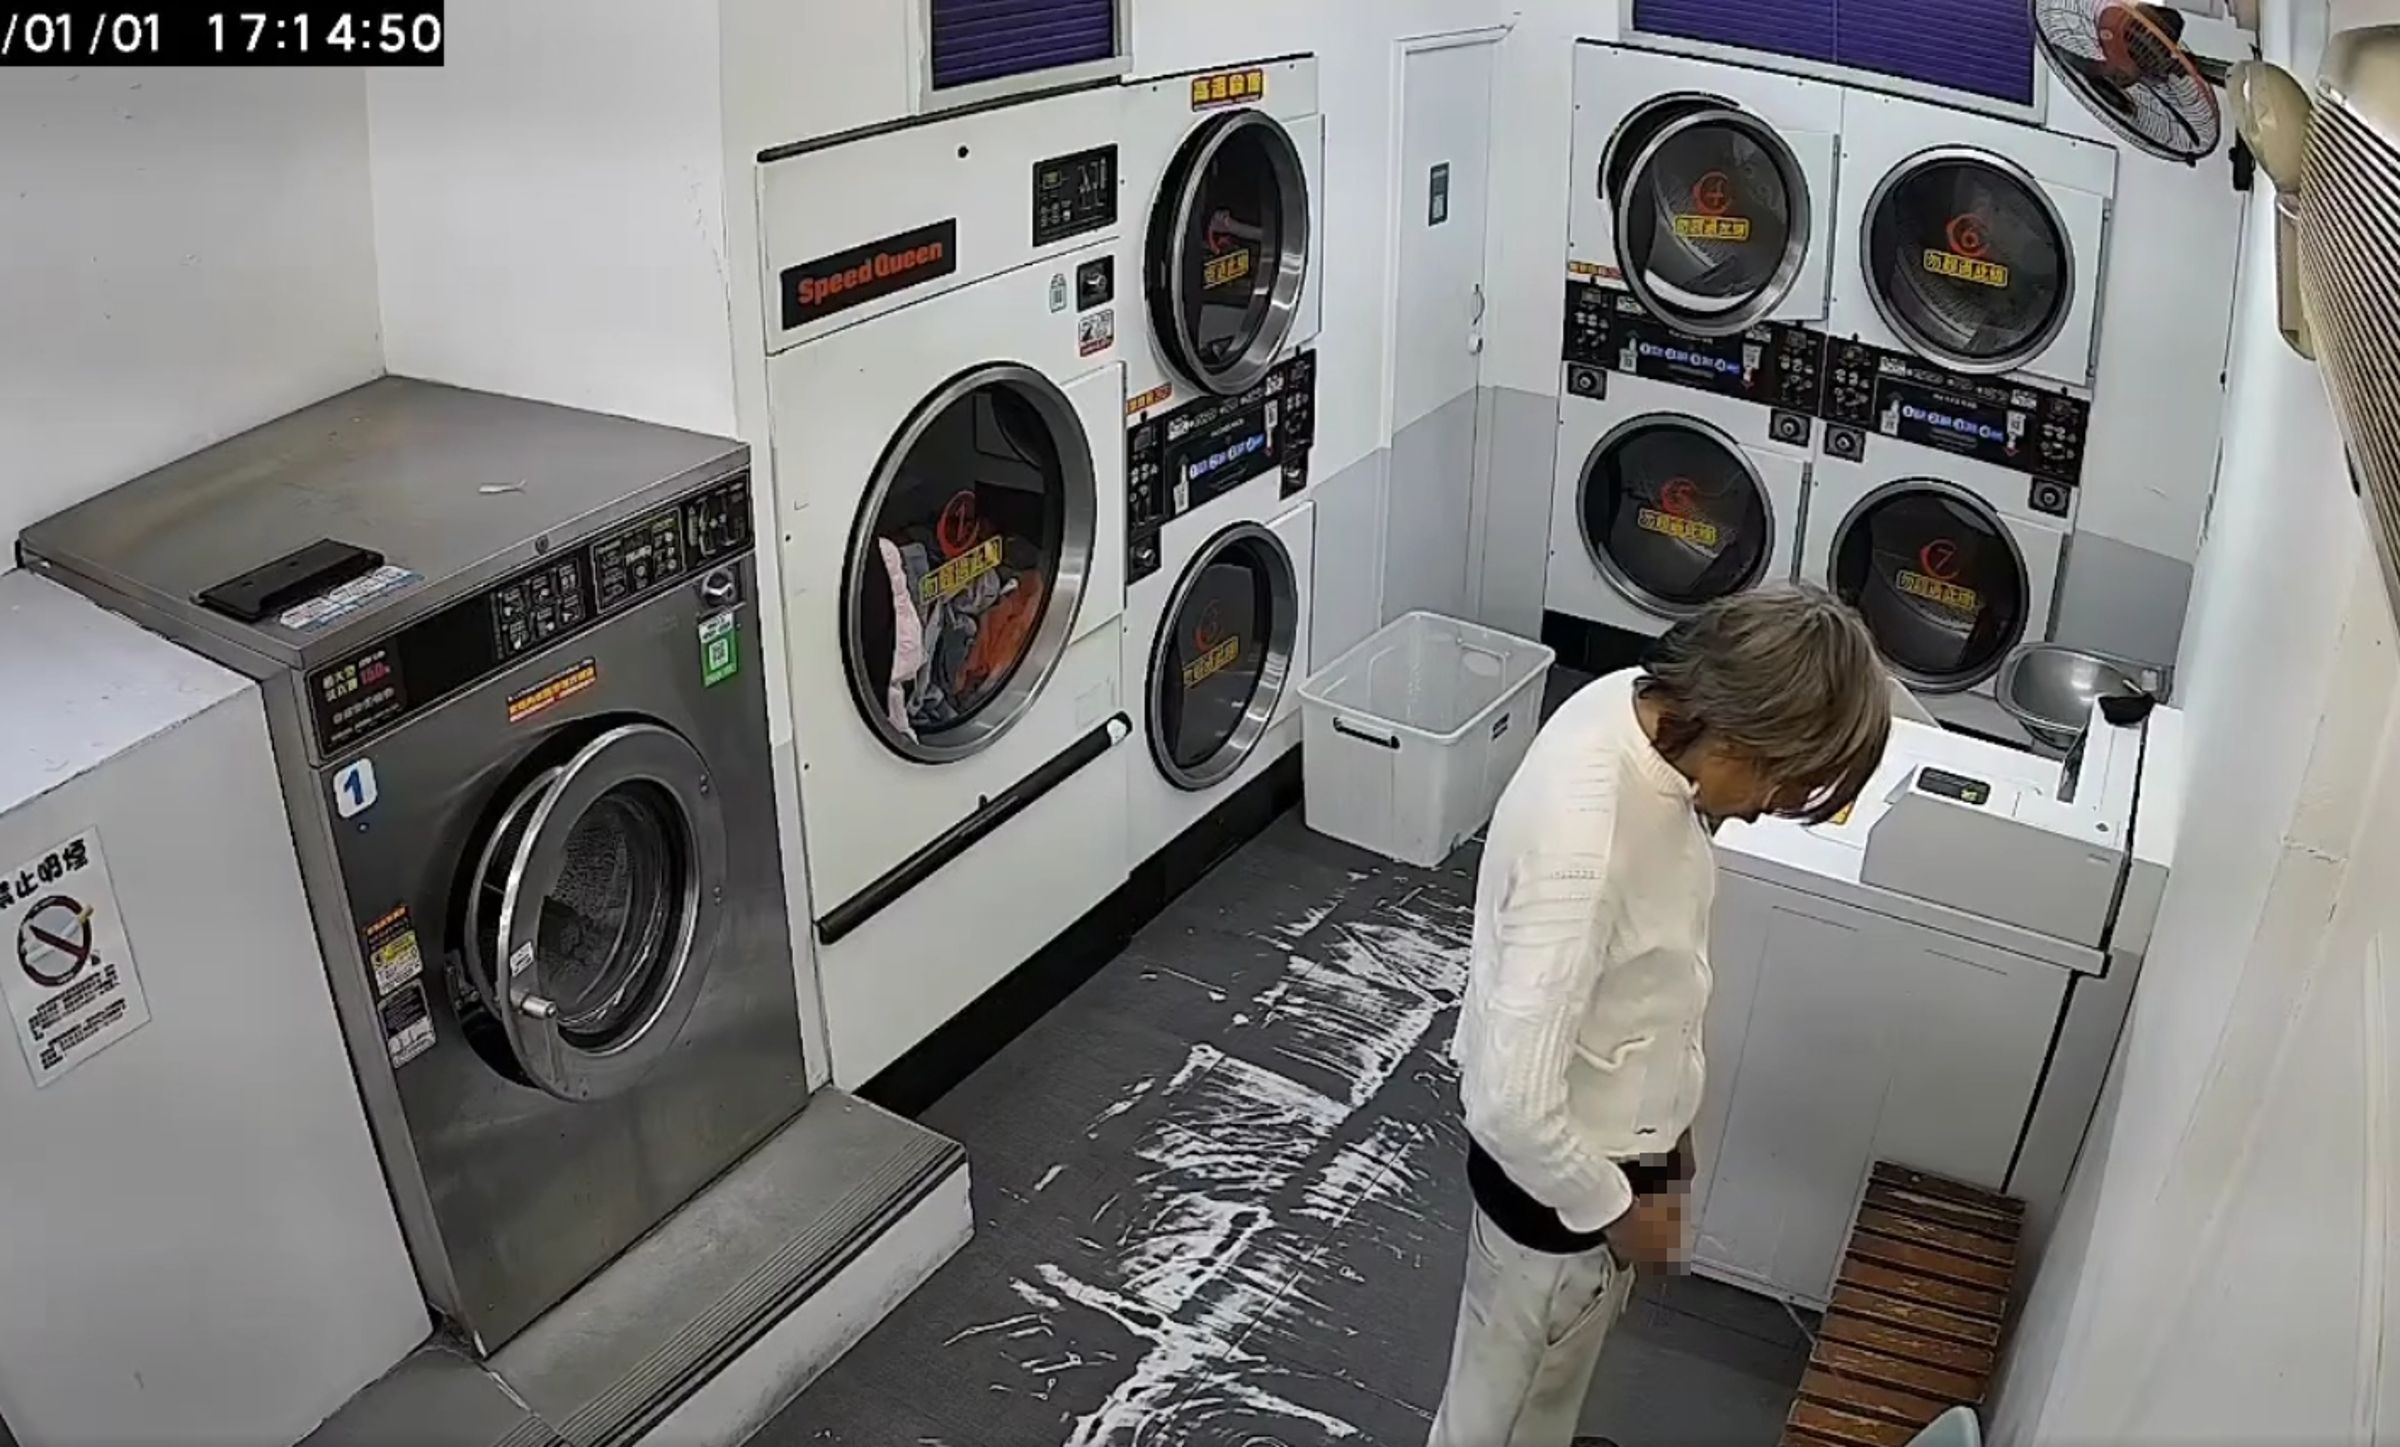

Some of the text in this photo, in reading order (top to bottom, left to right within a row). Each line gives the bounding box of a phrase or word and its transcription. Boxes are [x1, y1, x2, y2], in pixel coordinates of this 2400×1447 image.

[797, 241, 944, 305] Speed Queen
[342, 768, 366, 807] 1
